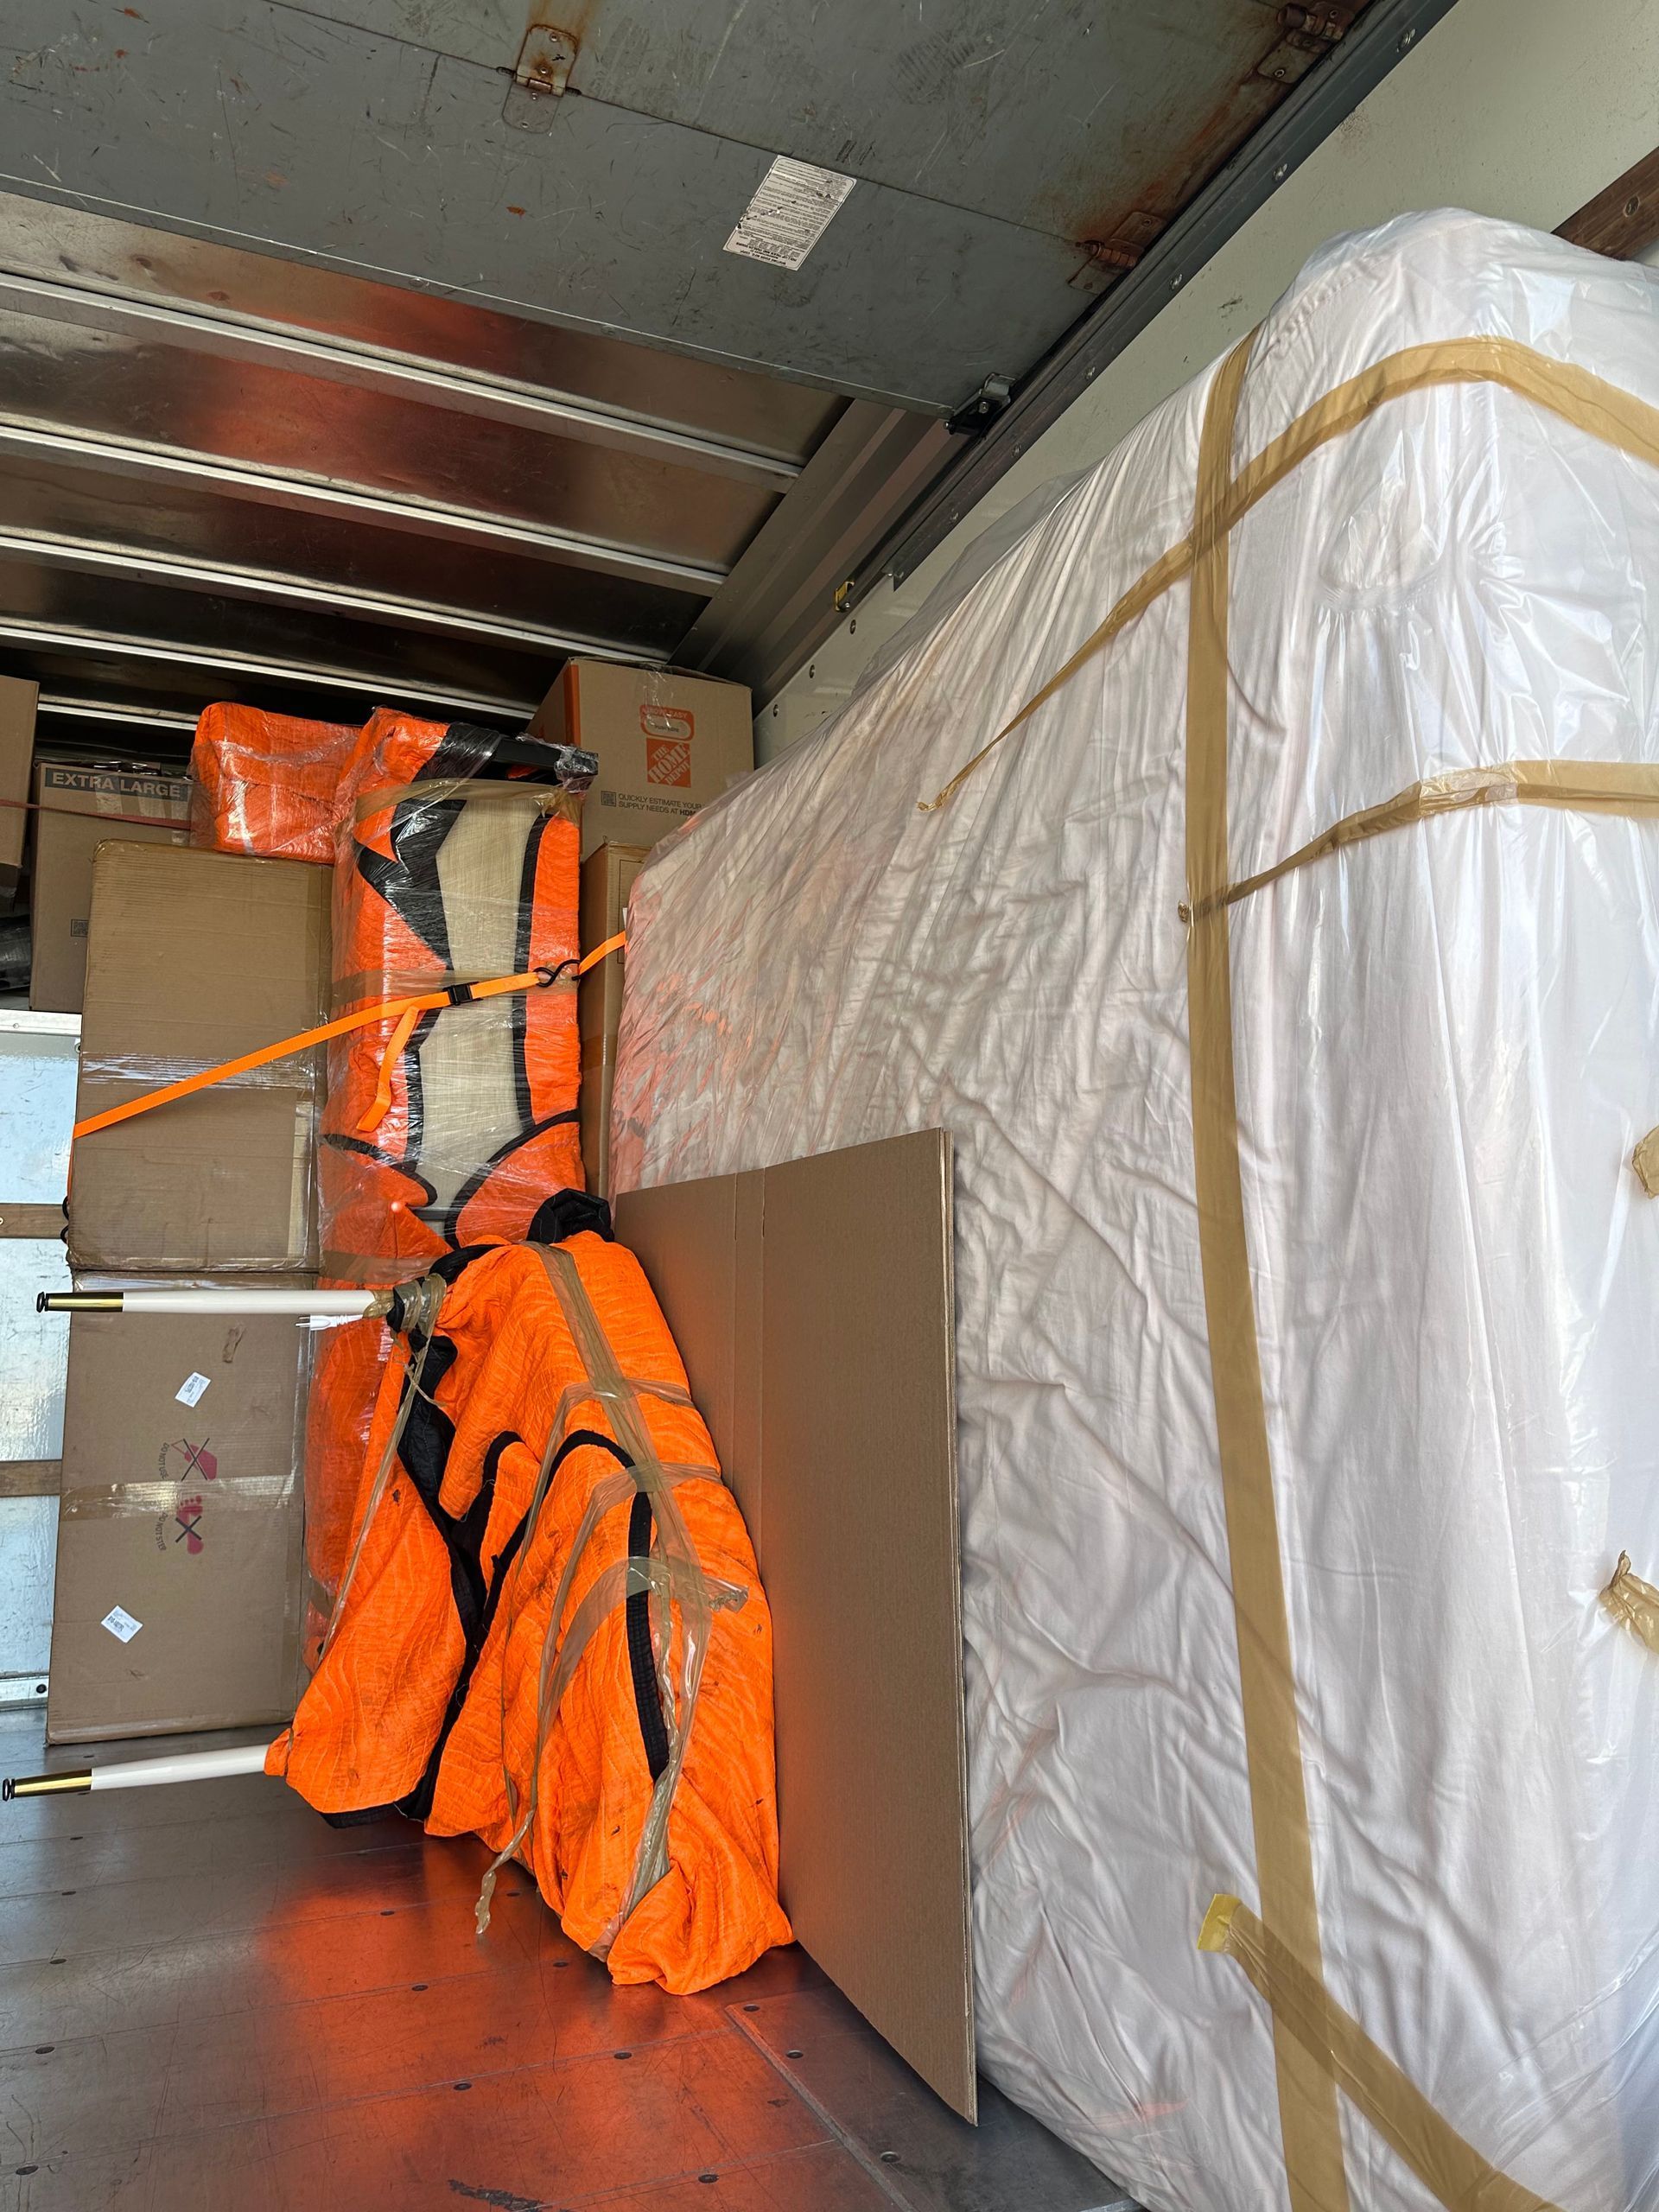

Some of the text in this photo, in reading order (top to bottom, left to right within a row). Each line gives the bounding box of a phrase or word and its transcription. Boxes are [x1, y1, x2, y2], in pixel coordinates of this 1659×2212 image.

[654, 745, 669, 760] THE
[649, 742, 690, 783] HOME
[665, 760, 690, 785] DEPOT
[53, 772, 180, 798] EXTRA LARGE
[619, 793, 648, 804] QUICKLY
[649, 798, 681, 808] ESTIMATE
[619, 801, 645, 810] SUPPLY
[646, 805, 669, 814] NEEDS
[161, 1442, 170, 1452] DO
[158, 1452, 167, 1466] NOT
